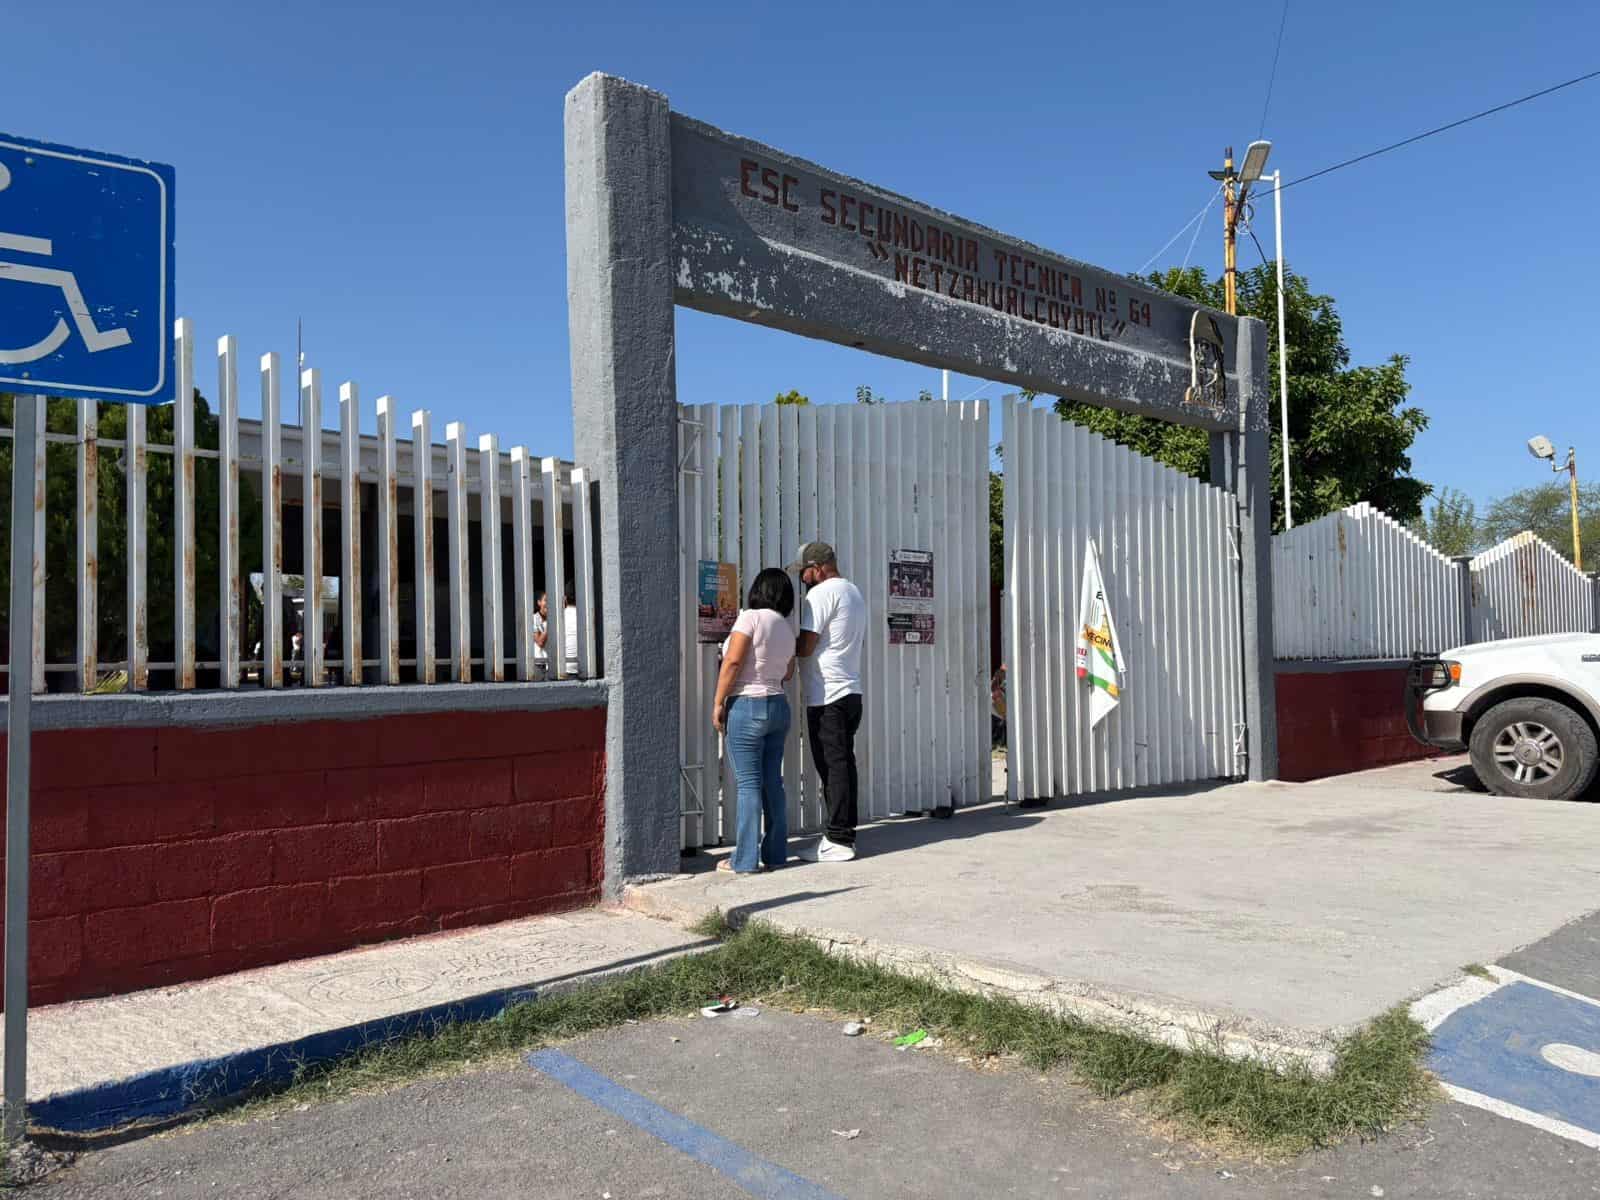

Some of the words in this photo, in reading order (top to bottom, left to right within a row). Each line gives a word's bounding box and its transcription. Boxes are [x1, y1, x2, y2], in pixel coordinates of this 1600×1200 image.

[740, 158, 800, 213] ESC
[820, 188, 979, 273] SECUNDARIA
[993, 249, 1082, 306] TECNICA
[1129, 298, 1151, 328] 64
